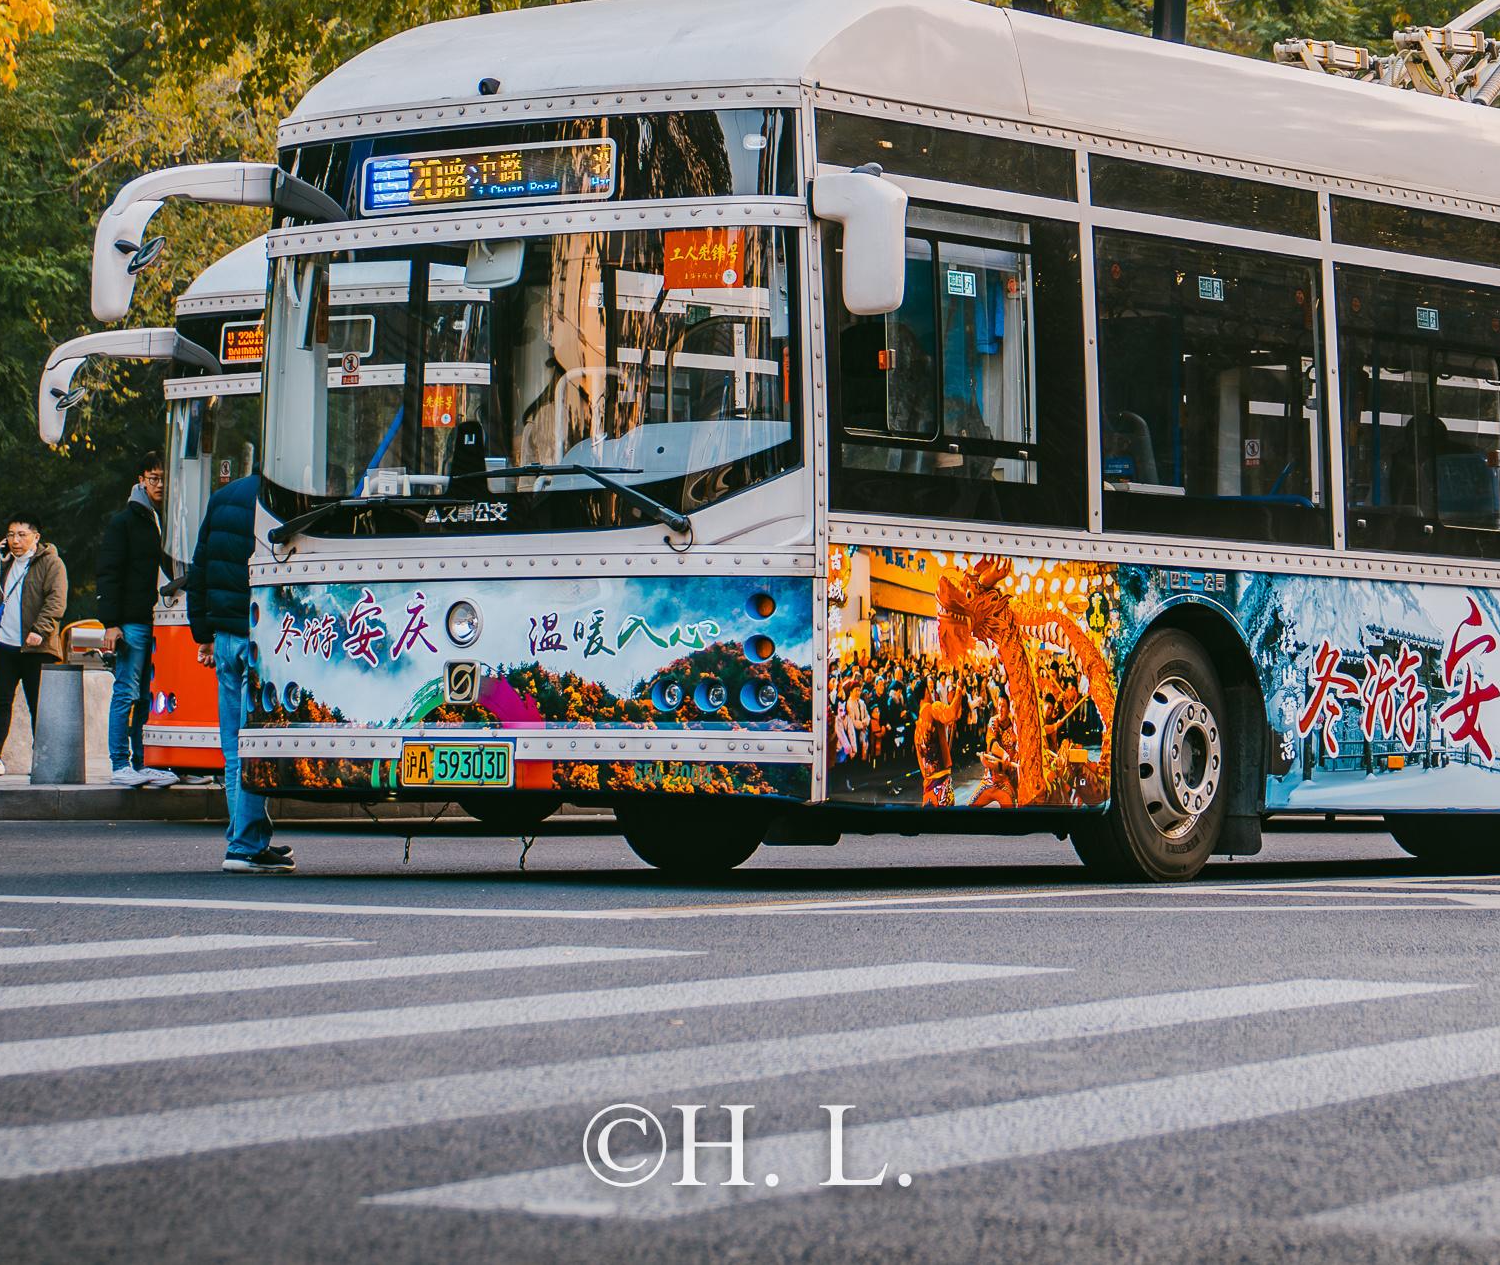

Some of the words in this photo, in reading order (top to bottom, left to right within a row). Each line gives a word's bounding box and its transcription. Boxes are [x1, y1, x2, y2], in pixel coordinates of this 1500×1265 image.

[670, 243, 739, 264] 工人先锋号
[423, 395, 454, 411] 先锋号
[273, 588, 438, 668] 冬游安庆
[406, 750, 430, 779] 沪A
[438, 750, 508, 779] 59303D
